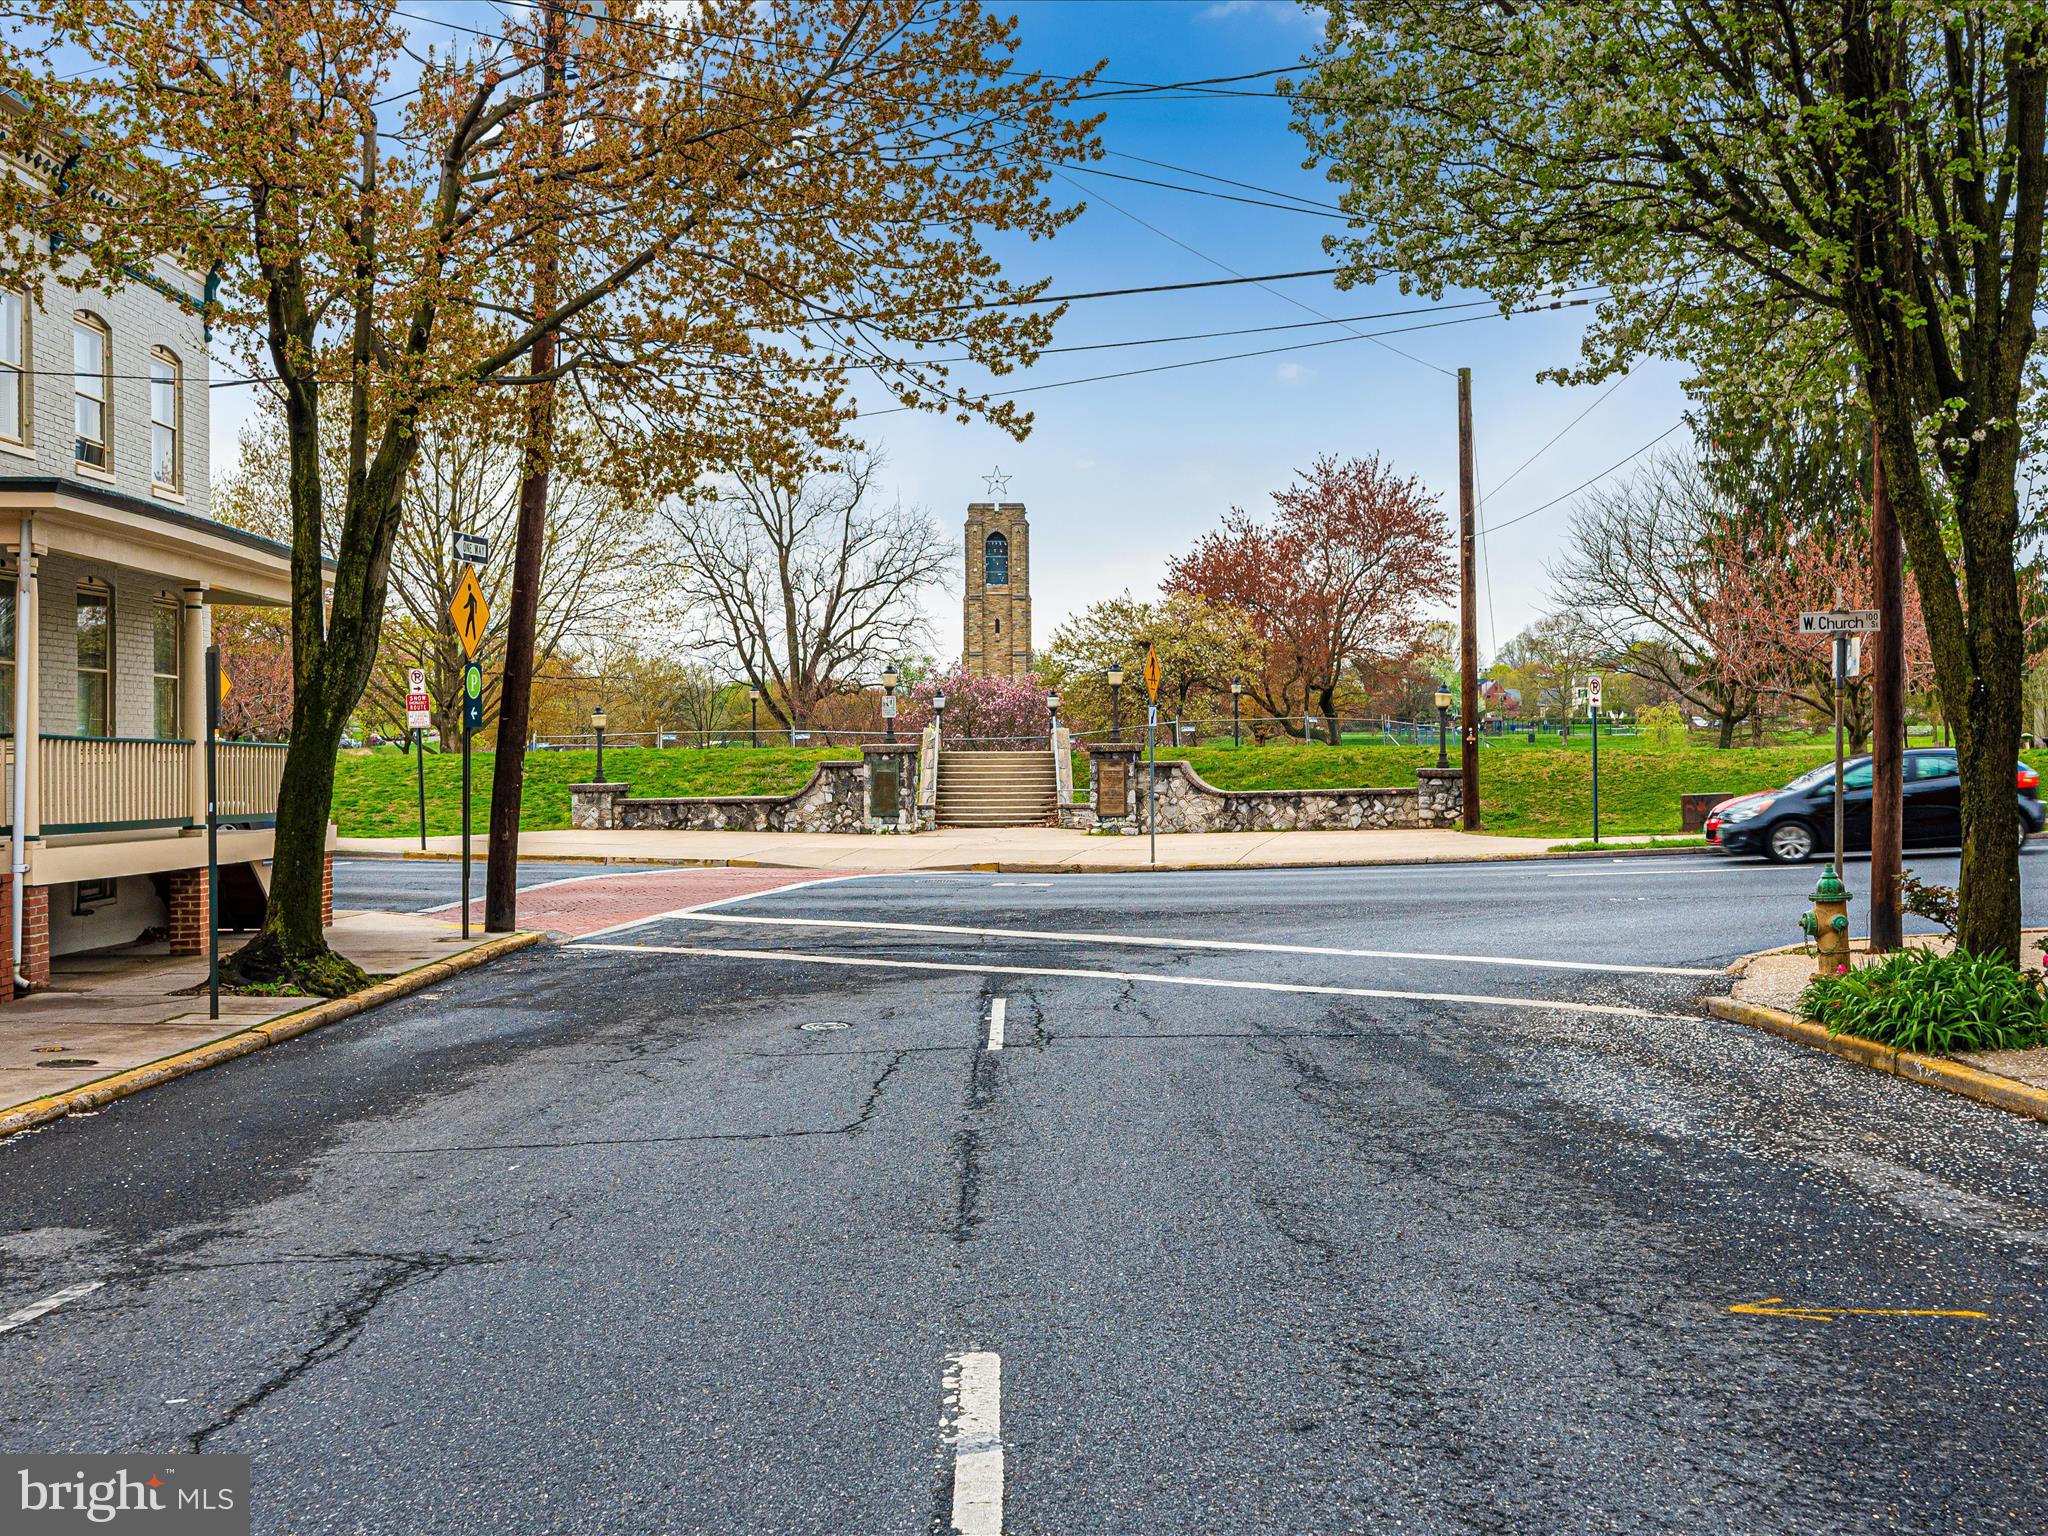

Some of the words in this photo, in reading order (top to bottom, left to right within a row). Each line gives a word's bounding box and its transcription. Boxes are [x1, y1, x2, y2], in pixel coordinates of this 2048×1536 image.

[463, 541, 473, 554] ONE
[474, 544, 486, 556] WAY
[1803, 616, 1816, 631] W.
[1818, 615, 1864, 630] Church
[1865, 613, 1879, 621] 100
[1870, 620, 1879, 628] St
[470, 674, 478, 692] P
